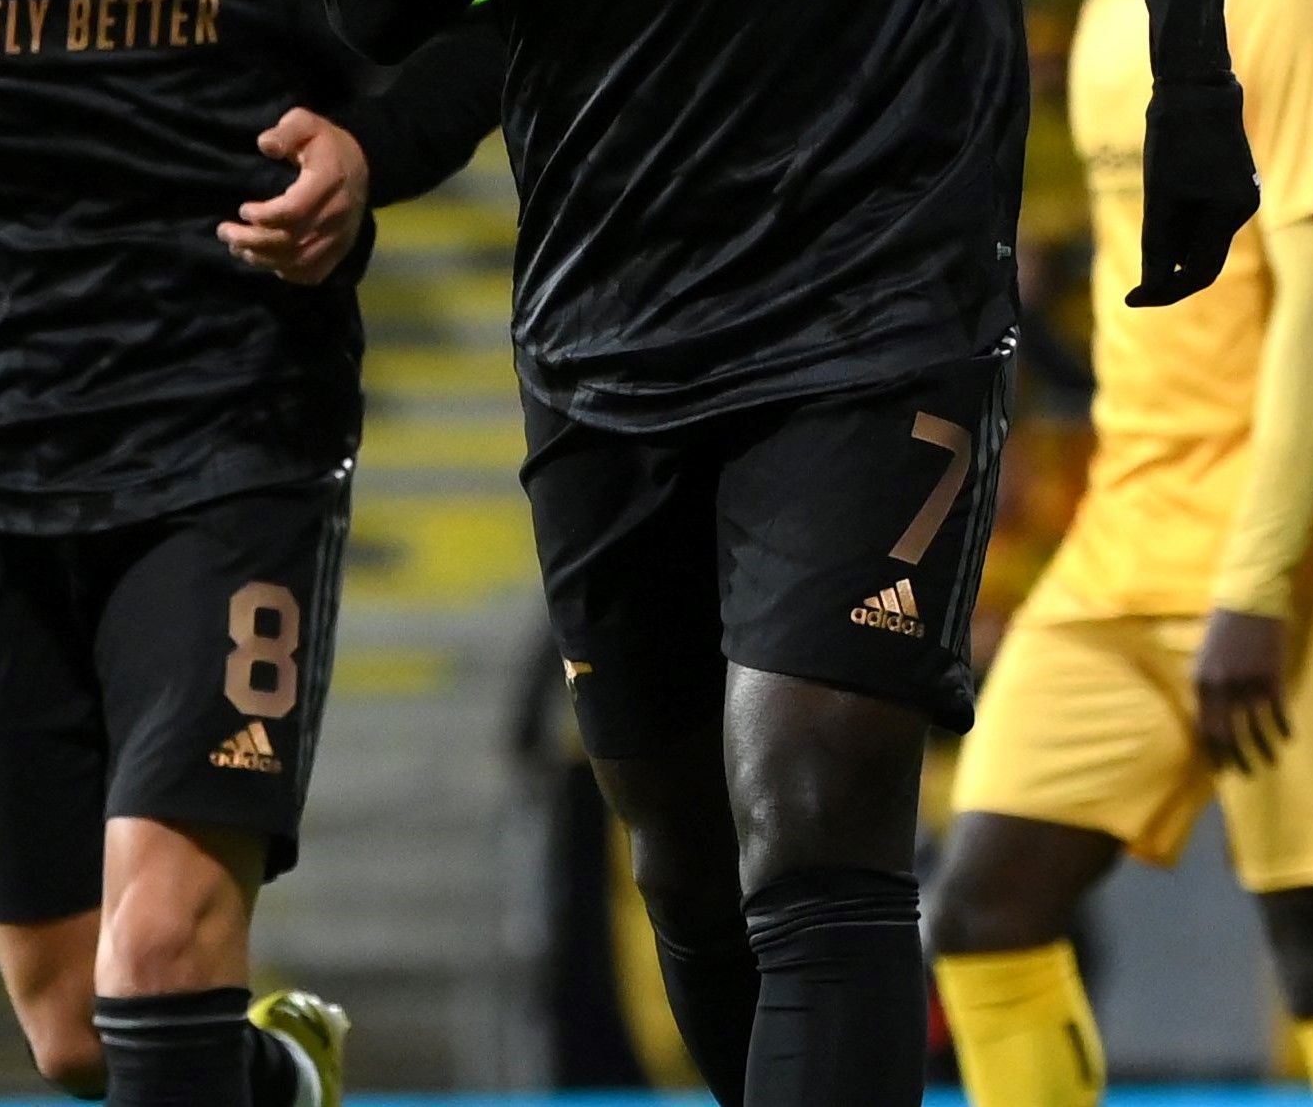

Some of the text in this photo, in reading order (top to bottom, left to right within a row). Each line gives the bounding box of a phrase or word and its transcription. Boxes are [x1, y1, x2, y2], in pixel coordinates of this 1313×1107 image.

[888, 410, 973, 565] 7
[223, 581, 301, 719] 8
[850, 607, 925, 638] adidas
